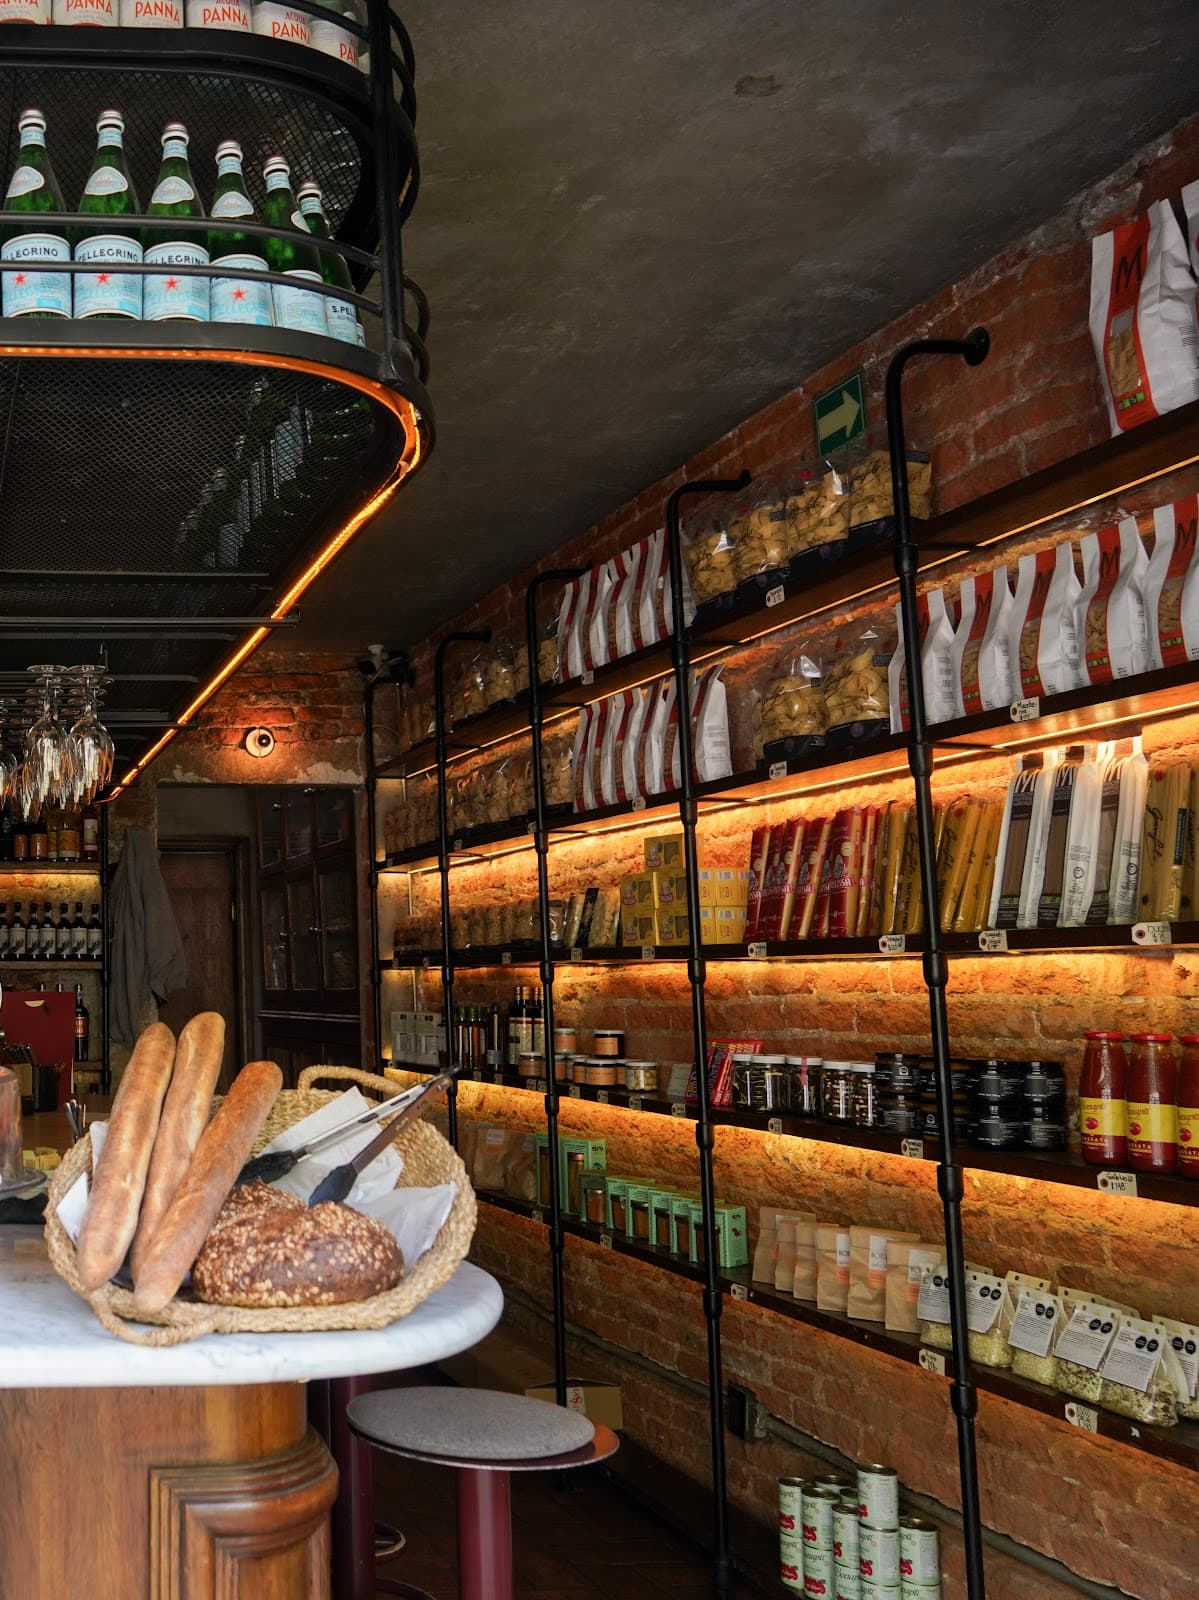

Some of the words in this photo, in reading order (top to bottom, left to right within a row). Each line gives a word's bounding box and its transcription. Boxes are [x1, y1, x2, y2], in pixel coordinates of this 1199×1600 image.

[66, 0, 113, 16] PANNA
[135, 1, 180, 25] PANNA
[202, 6, 249, 30] PANNA
